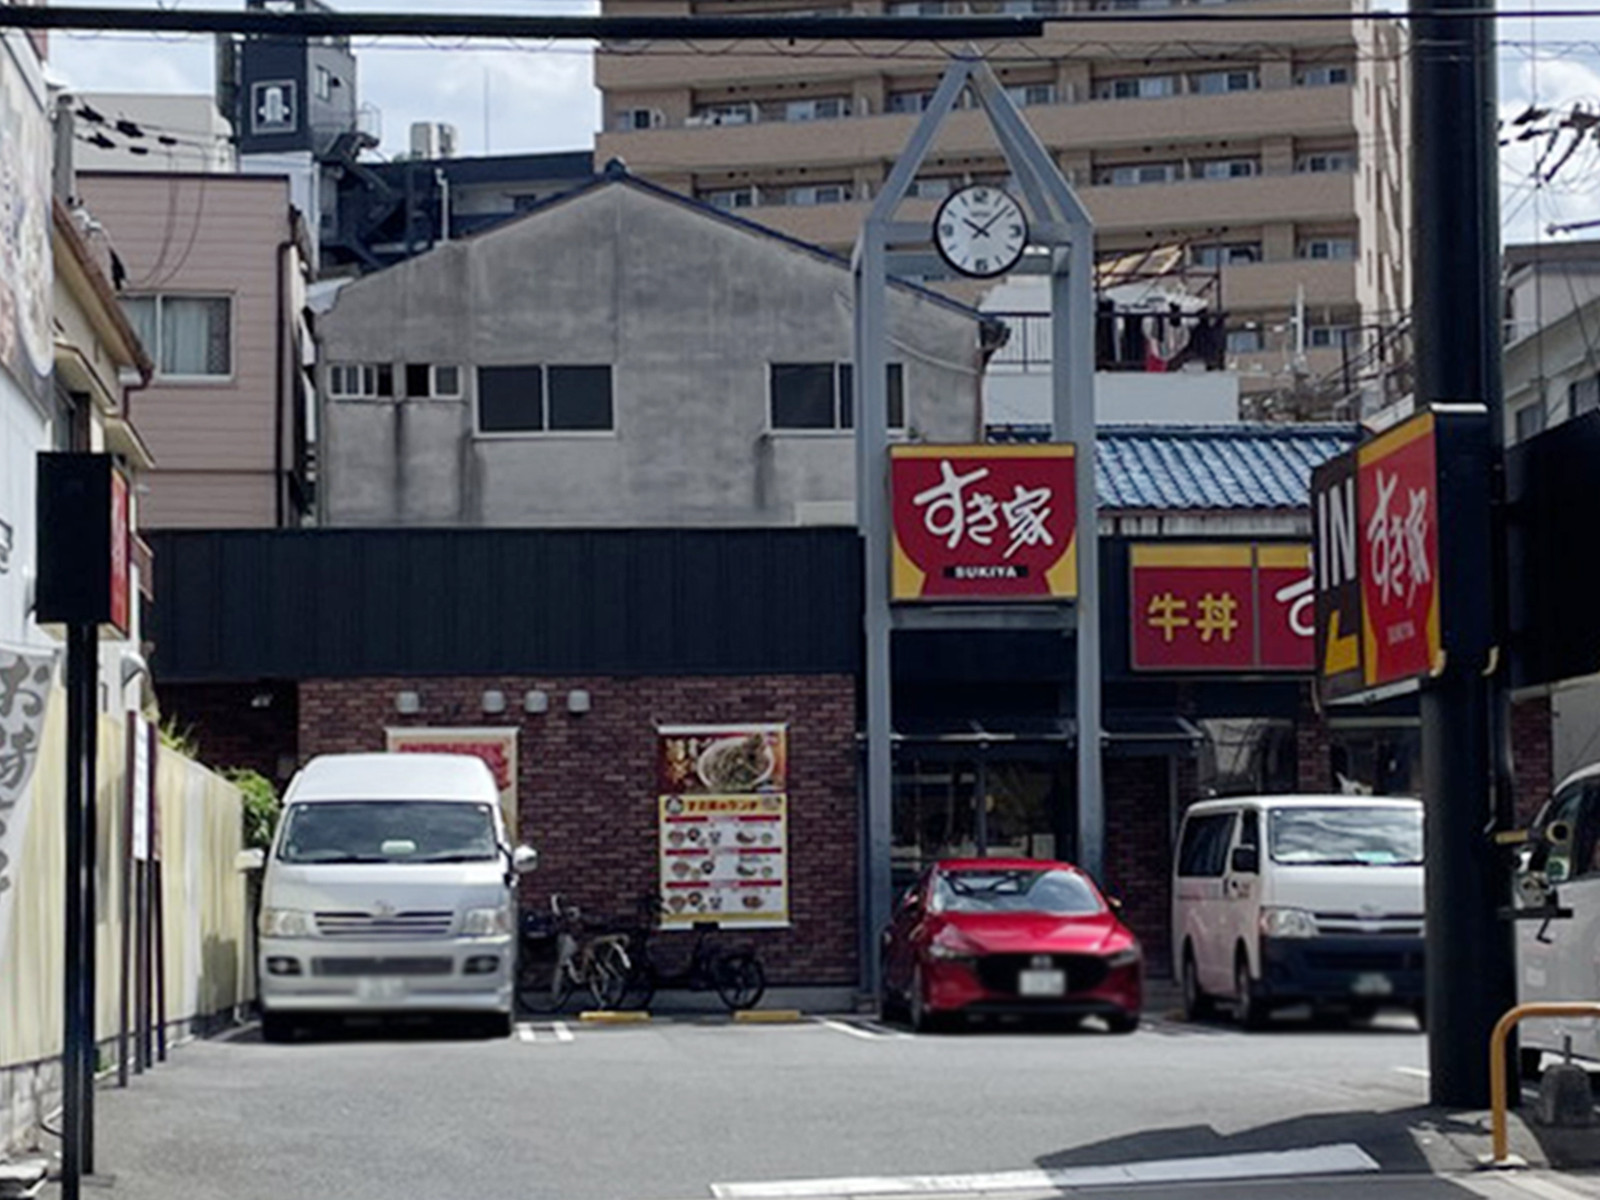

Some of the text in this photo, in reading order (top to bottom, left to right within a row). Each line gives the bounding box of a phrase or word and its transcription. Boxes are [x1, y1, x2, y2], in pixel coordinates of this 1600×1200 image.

[1008, 224, 1022, 238] 3
[913, 460, 1053, 559] すき家
[1319, 477, 1356, 591] IN
[1367, 468, 1430, 609] すき家
[954, 565, 1017, 578] SUKIYA
[1148, 592, 1238, 642] 牛丼
